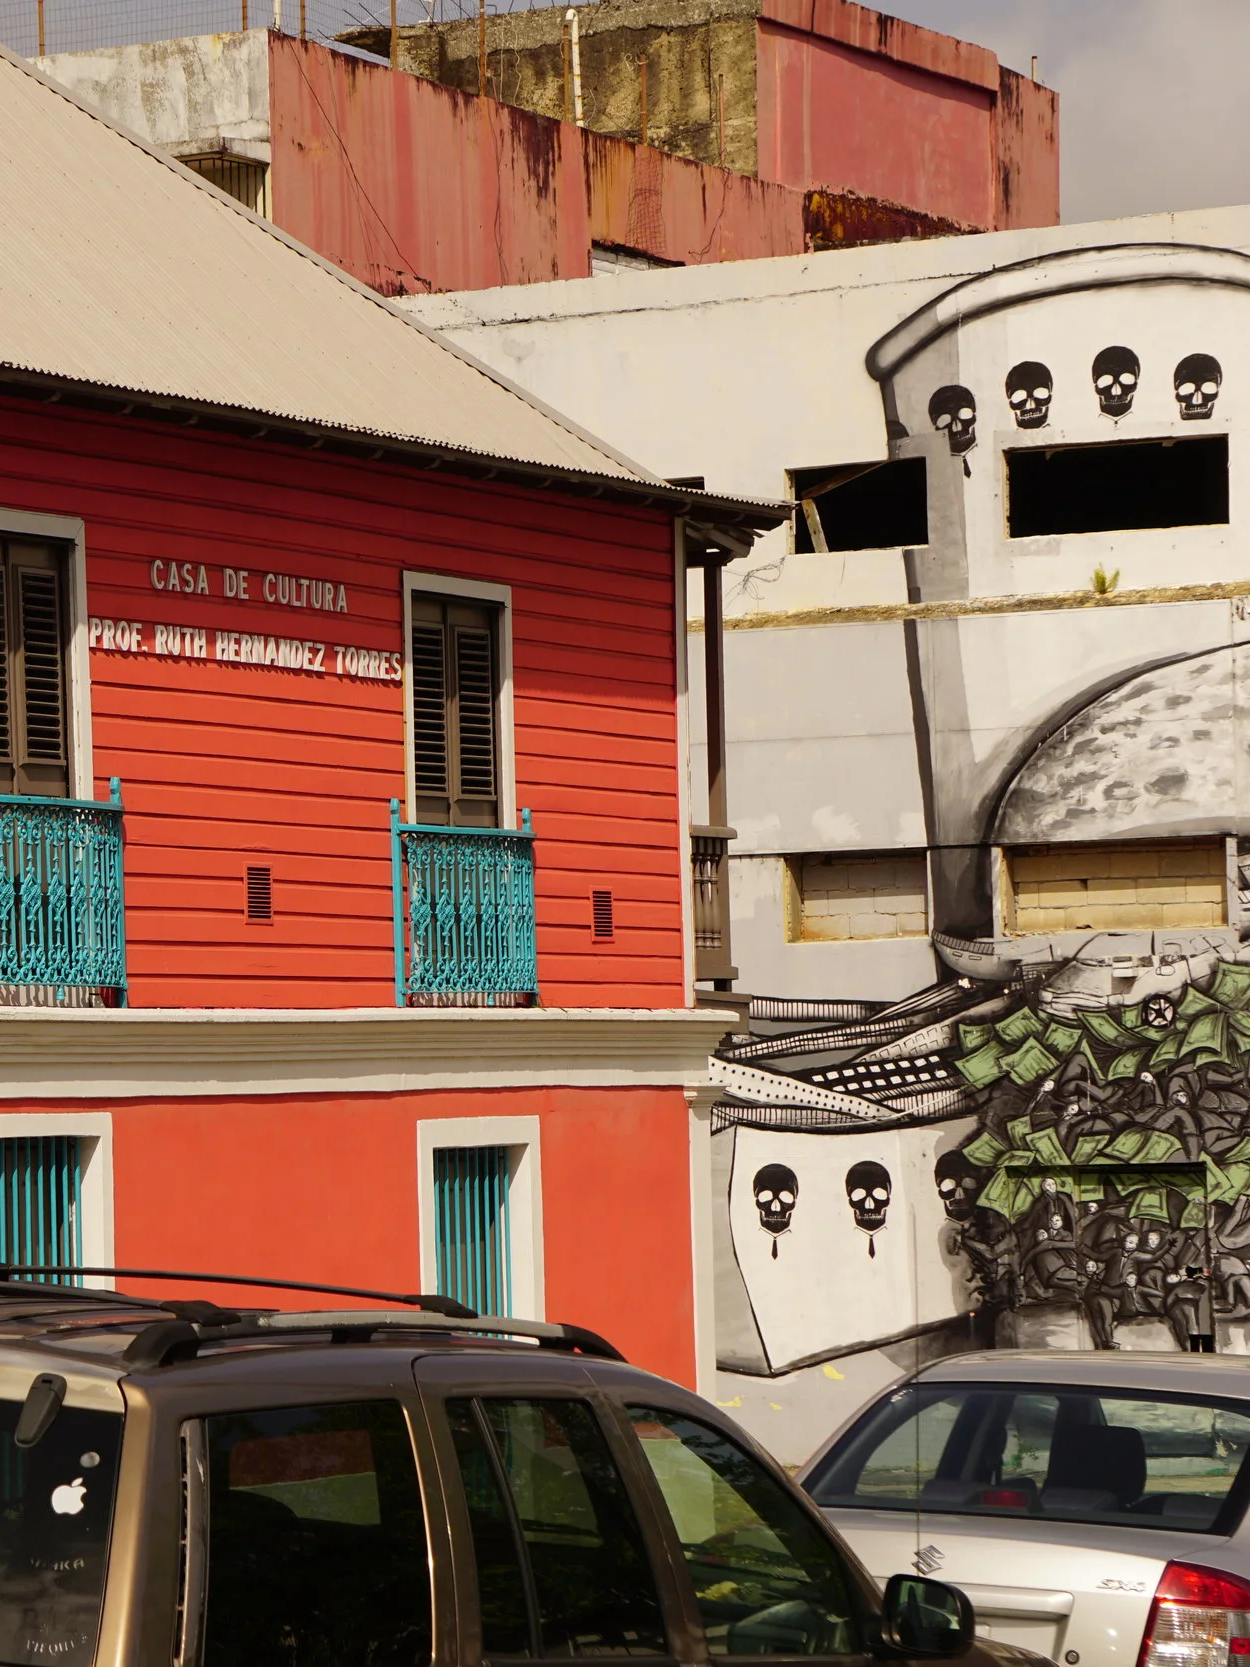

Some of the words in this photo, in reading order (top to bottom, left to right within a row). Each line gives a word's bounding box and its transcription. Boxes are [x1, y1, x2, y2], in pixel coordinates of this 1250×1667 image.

[150, 559, 209, 595] CASA
[223, 568, 250, 600] DE
[263, 573, 348, 613] CULTURA
[89, 617, 148, 653] PROF.
[154, 624, 207, 659] RUTH
[215, 631, 326, 672] HERNANDEZ
[333, 646, 402, 681] TORRES
